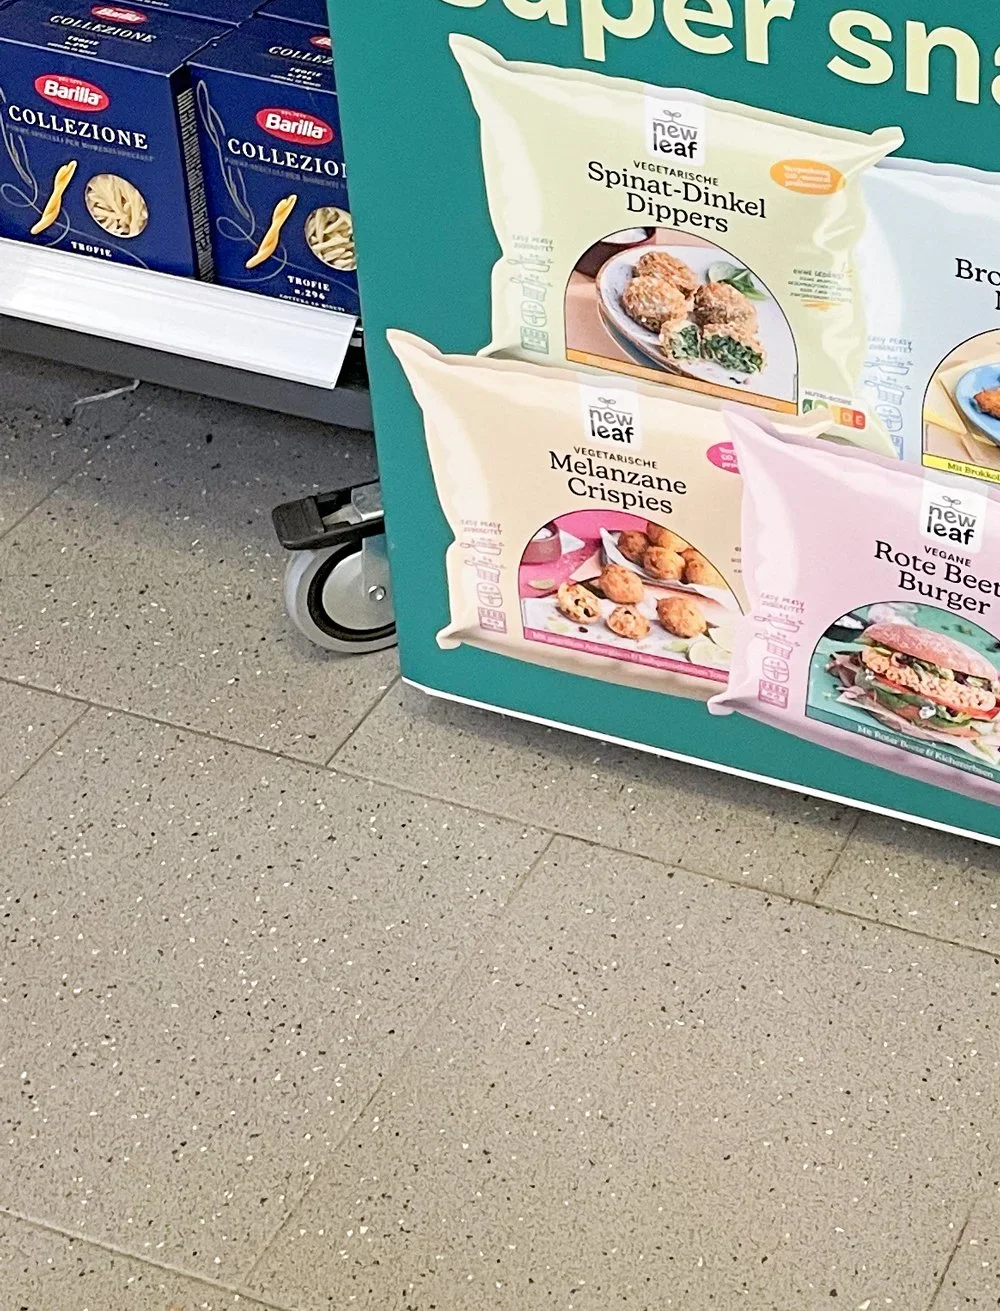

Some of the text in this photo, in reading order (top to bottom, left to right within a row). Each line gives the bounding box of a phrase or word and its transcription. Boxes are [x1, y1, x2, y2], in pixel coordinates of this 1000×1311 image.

[50, 15, 157, 43] COLLEZIONE
[44, 80, 102, 106] Barilla
[8, 105, 148, 150] COLLEZIONE
[265, 114, 327, 139] Barilla
[652, 119, 698, 141] new
[653, 134, 698, 159] leaf
[633, 160, 719, 186] VEGETARISCHE
[587, 161, 767, 219] Spinat-Dinkel
[626, 192, 729, 234] Dippers
[71, 241, 112, 257] TROFIE
[287, 275, 330, 292] TROFIE
[589, 409, 633, 426] new
[590, 420, 634, 444] leaf
[573, 445, 658, 470] VEGETARISCHE
[549, 451, 687, 495] Melanzane
[567, 477, 673, 515] Crispies
[928, 506, 976, 529] new
[927, 516, 975, 546] leaf
[874, 540, 937, 577] Rote
[924, 545, 972, 568] VEGANE
[897, 570, 991, 617] Burger
